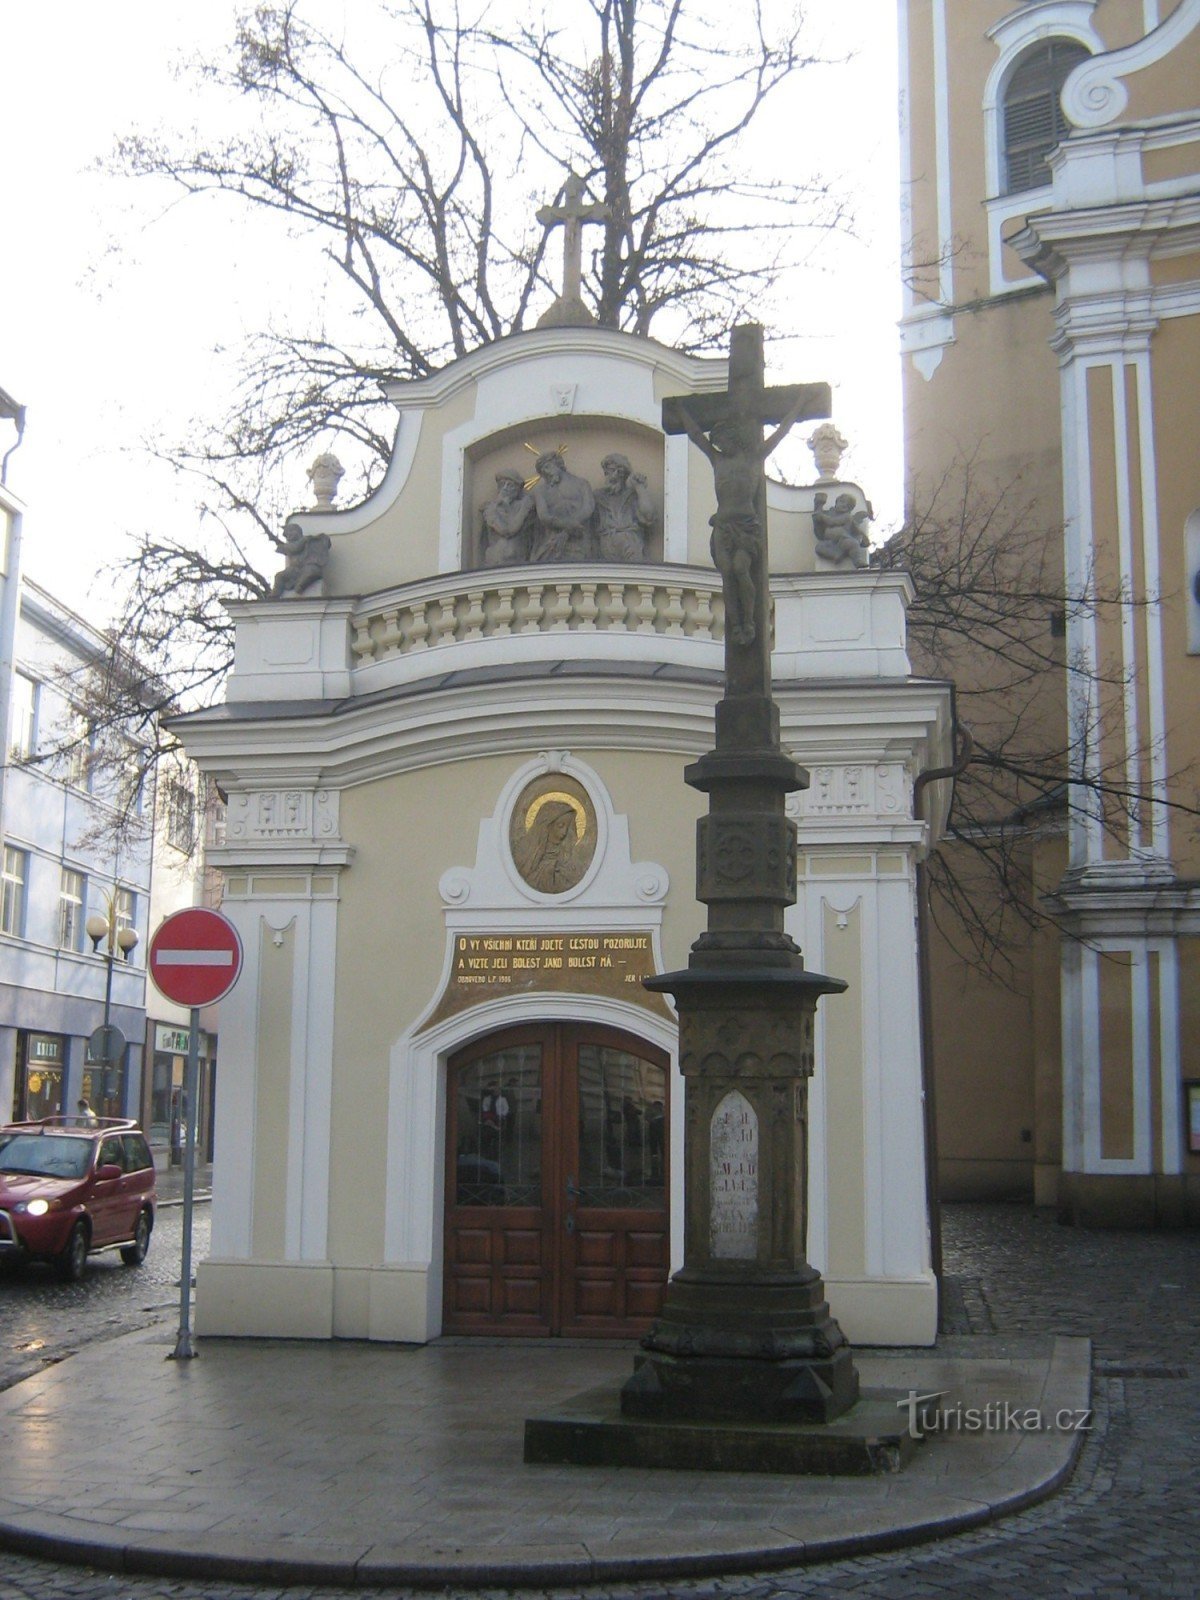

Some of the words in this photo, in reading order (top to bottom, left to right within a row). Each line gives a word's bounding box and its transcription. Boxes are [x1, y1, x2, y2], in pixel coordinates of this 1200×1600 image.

[460, 938, 466, 950] O
[470, 939, 480, 950] VY
[541, 939, 563, 950] JDETE
[570, 938, 599, 949] CESTOU
[603, 938, 647, 949] POZORUJTE
[459, 958, 464, 968] A
[468, 958, 488, 969] VIZTE
[492, 958, 507, 969] JELI
[513, 957, 540, 968] BOLEST
[543, 957, 562, 968] JAKO
[568, 956, 596, 968] BOLEST
